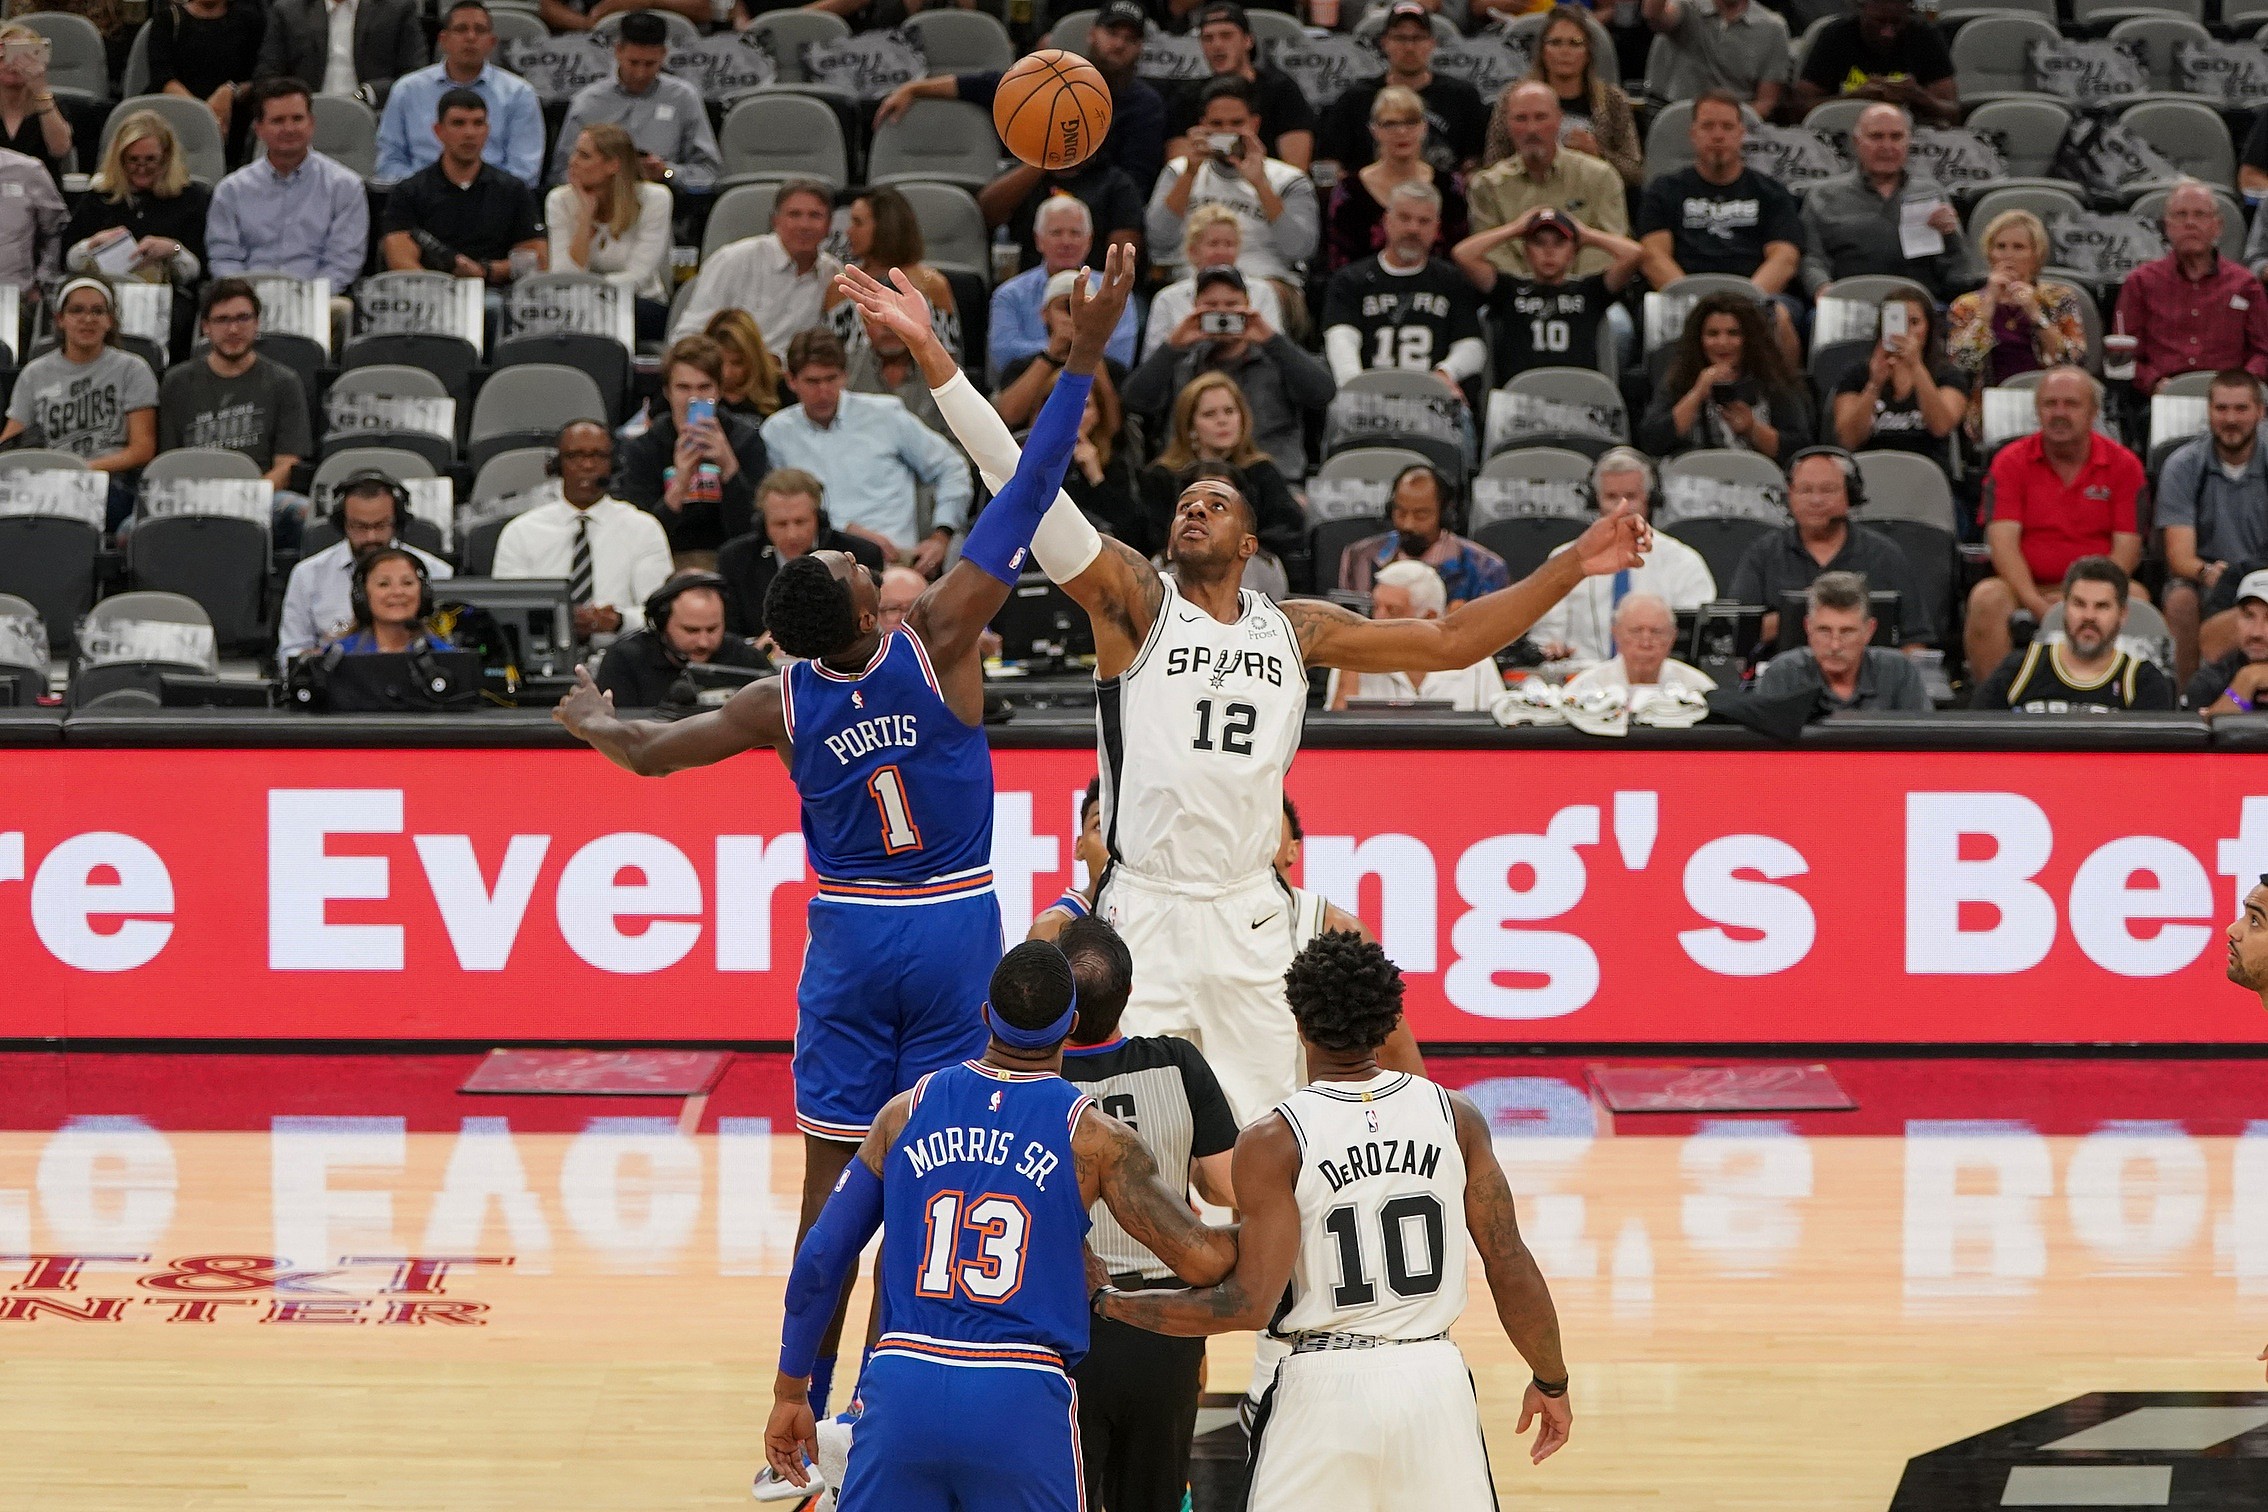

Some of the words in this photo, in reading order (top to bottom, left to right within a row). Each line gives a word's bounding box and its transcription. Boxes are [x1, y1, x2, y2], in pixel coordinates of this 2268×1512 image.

[1372, 325, 1434, 373] 12
[1530, 319, 1571, 352] 10
[50, 384, 117, 440] SPURS
[1248, 629, 1278, 640] Frost
[1167, 646, 1282, 690] SPURS
[824, 714, 918, 766] PORTIS
[1190, 697, 1259, 758] 12
[867, 766, 923, 855] 1
[903, 1127, 1016, 1179] MORRIS
[1016, 1140, 1060, 1193] SR.
[1318, 1139, 1442, 1194] DeROZAN
[915, 1189, 1032, 1304] 13
[1322, 1190, 1446, 1311] 10
